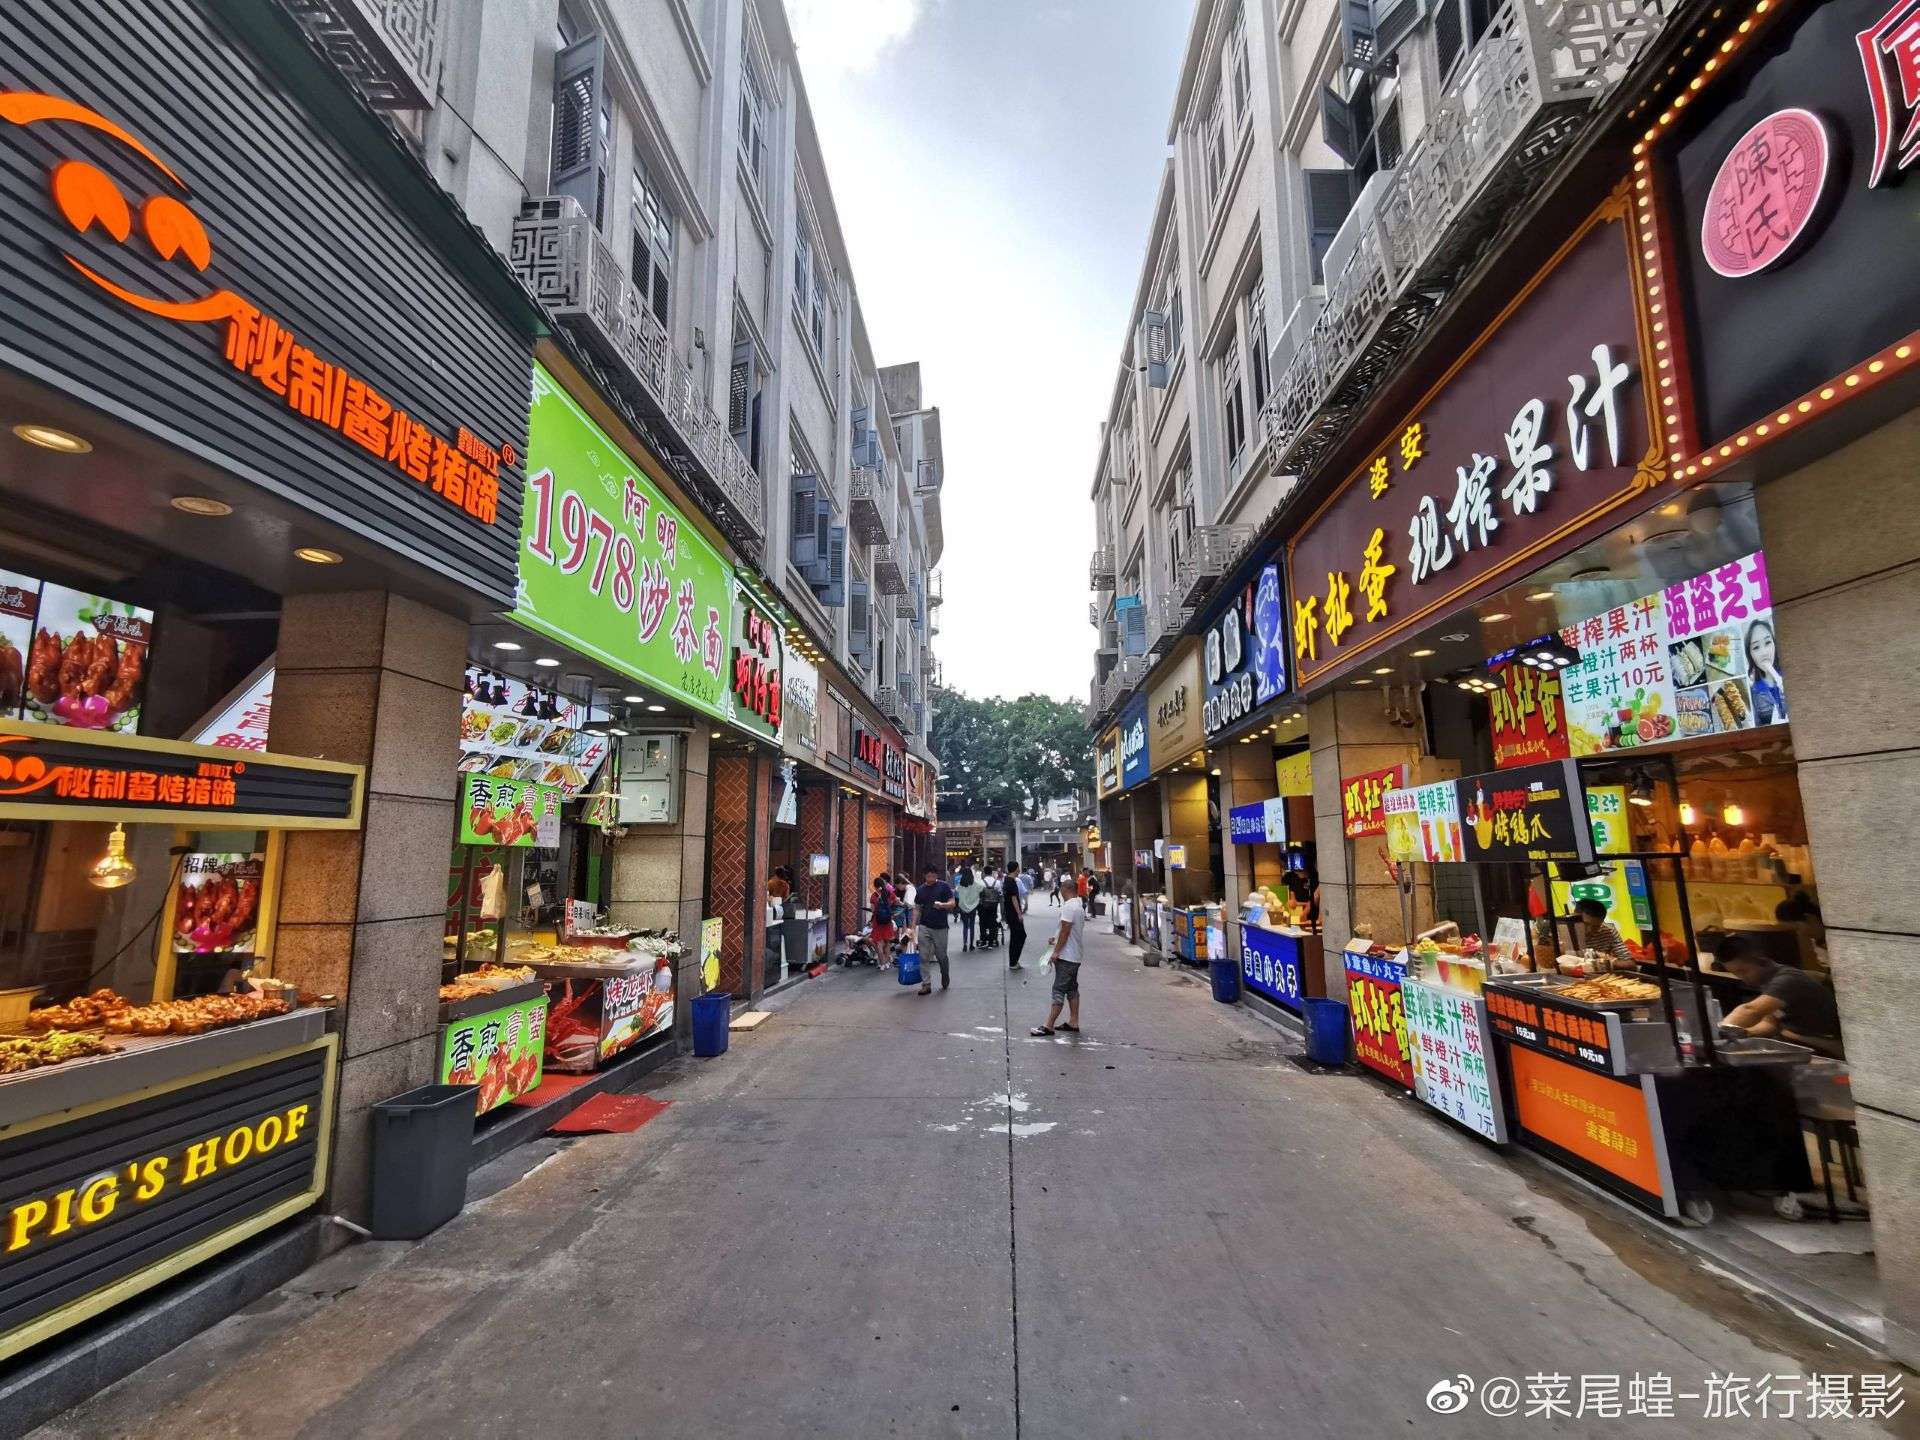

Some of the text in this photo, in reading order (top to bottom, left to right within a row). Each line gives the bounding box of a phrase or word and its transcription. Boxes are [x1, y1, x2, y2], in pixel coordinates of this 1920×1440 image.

[225, 305, 499, 525] 秘制酱烤猪蹄
[1408, 344, 1630, 586] 现榨果汁
[624, 475, 678, 570] 阿明
[527, 467, 725, 680] 1978沙茶面
[1295, 527, 1395, 661] 虾扯蛋
[1664, 549, 1771, 639] 海盗芝士
[1561, 597, 1655, 650] 鲜榨果汁
[1567, 661, 1664, 703] 芒果汁10元
[56, 766, 236, 806] 秘制酱烤猪蹄
[470, 778, 559, 816] 香煎膏蟹
[1417, 786, 1455, 816] 鲜榨果汁
[184, 856, 218, 874] 招牌
[605, 968, 654, 1010] 烤龙虾
[450, 1005, 545, 1072] 香煎膏蟹
[1351, 979, 1410, 1062] 虾扯蛋
[1460, 1000, 1483, 1055] 热饮
[1425, 1059, 1491, 1110] 芒果汁10元
[1428, 1086, 1495, 1137] 花生汤 7元
[9, 1104, 308, 1251] PIG'S HOOF
